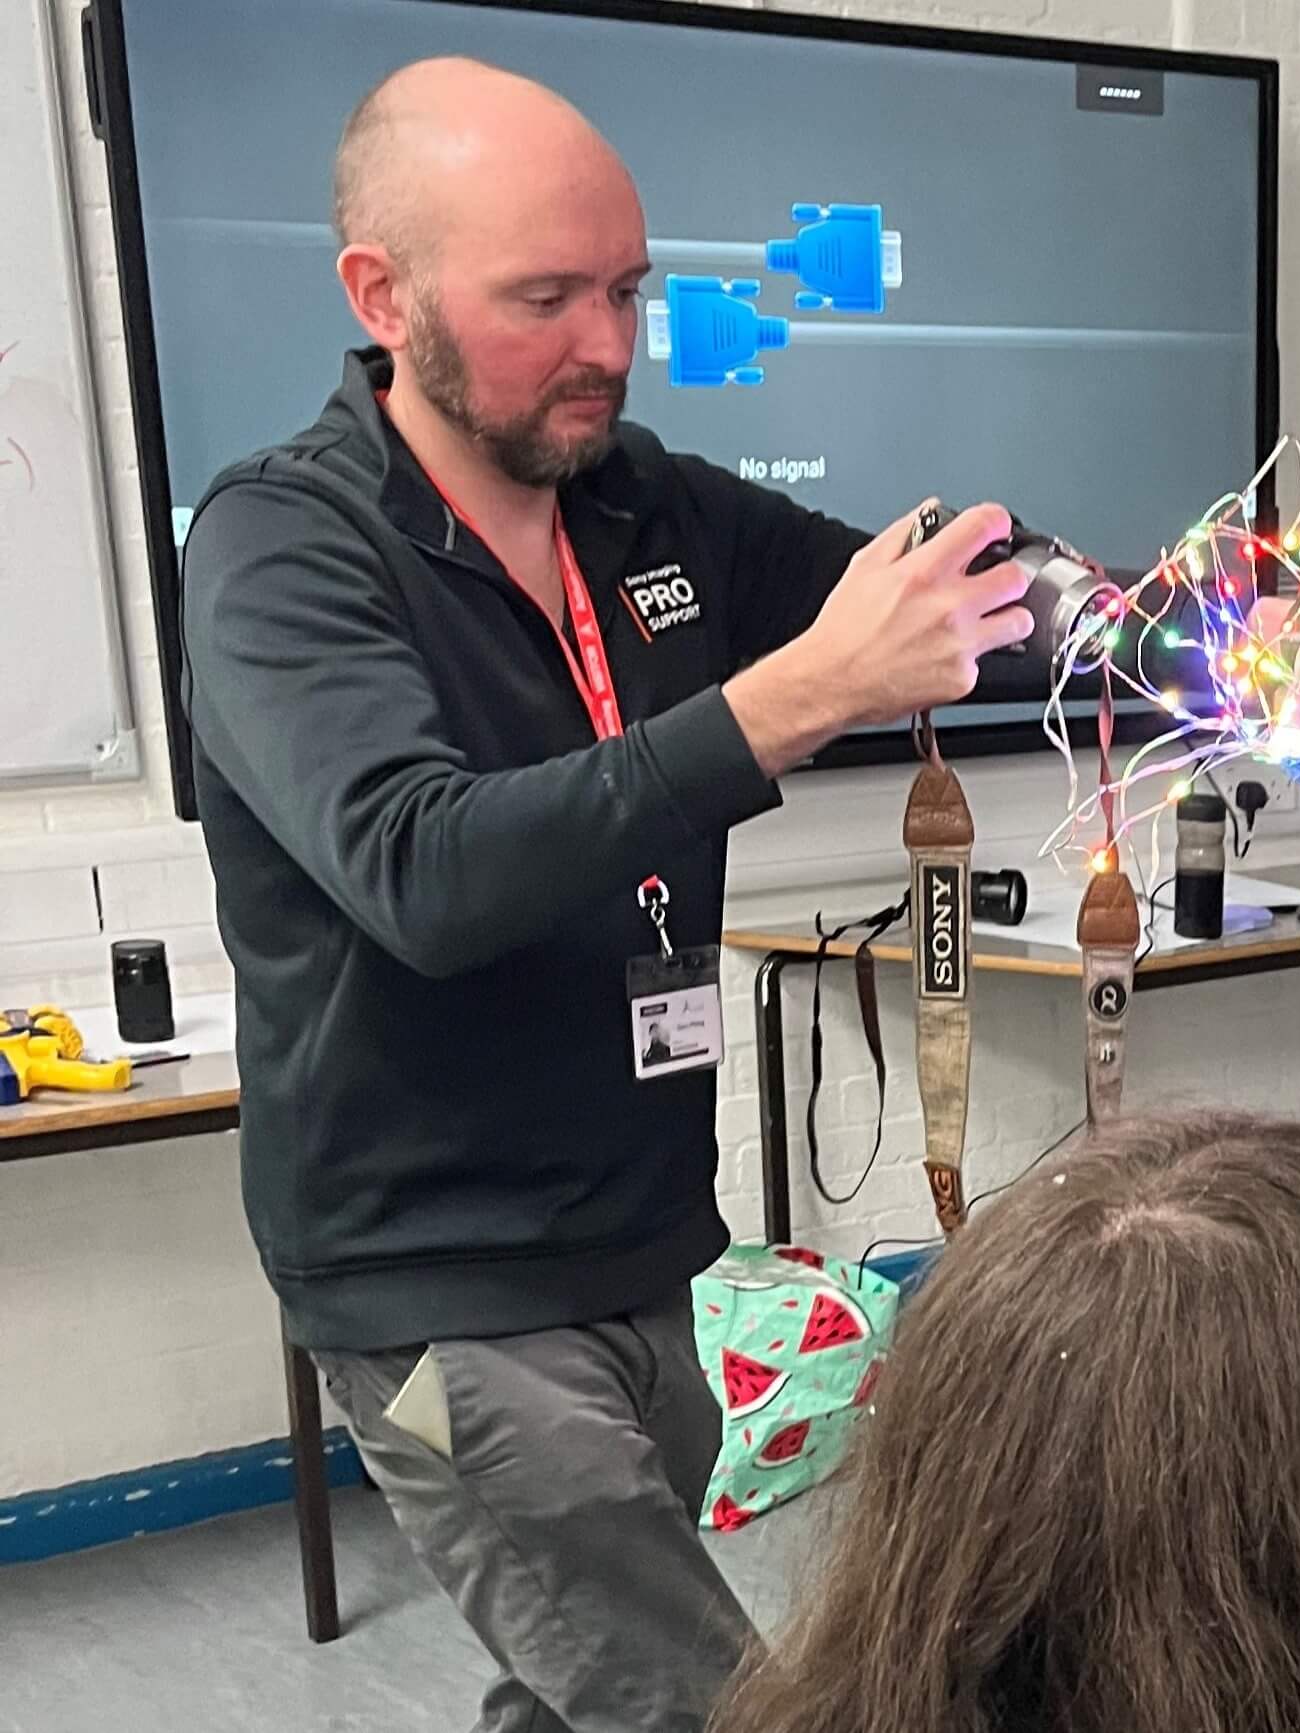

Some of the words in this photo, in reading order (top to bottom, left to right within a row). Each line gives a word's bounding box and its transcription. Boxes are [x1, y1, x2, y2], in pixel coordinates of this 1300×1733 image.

[739, 457, 768, 480] No
[770, 455, 826, 484] signal
[633, 577, 694, 617] PRO
[648, 603, 700, 632] SUPPORT
[932, 872, 953, 985] SONY
